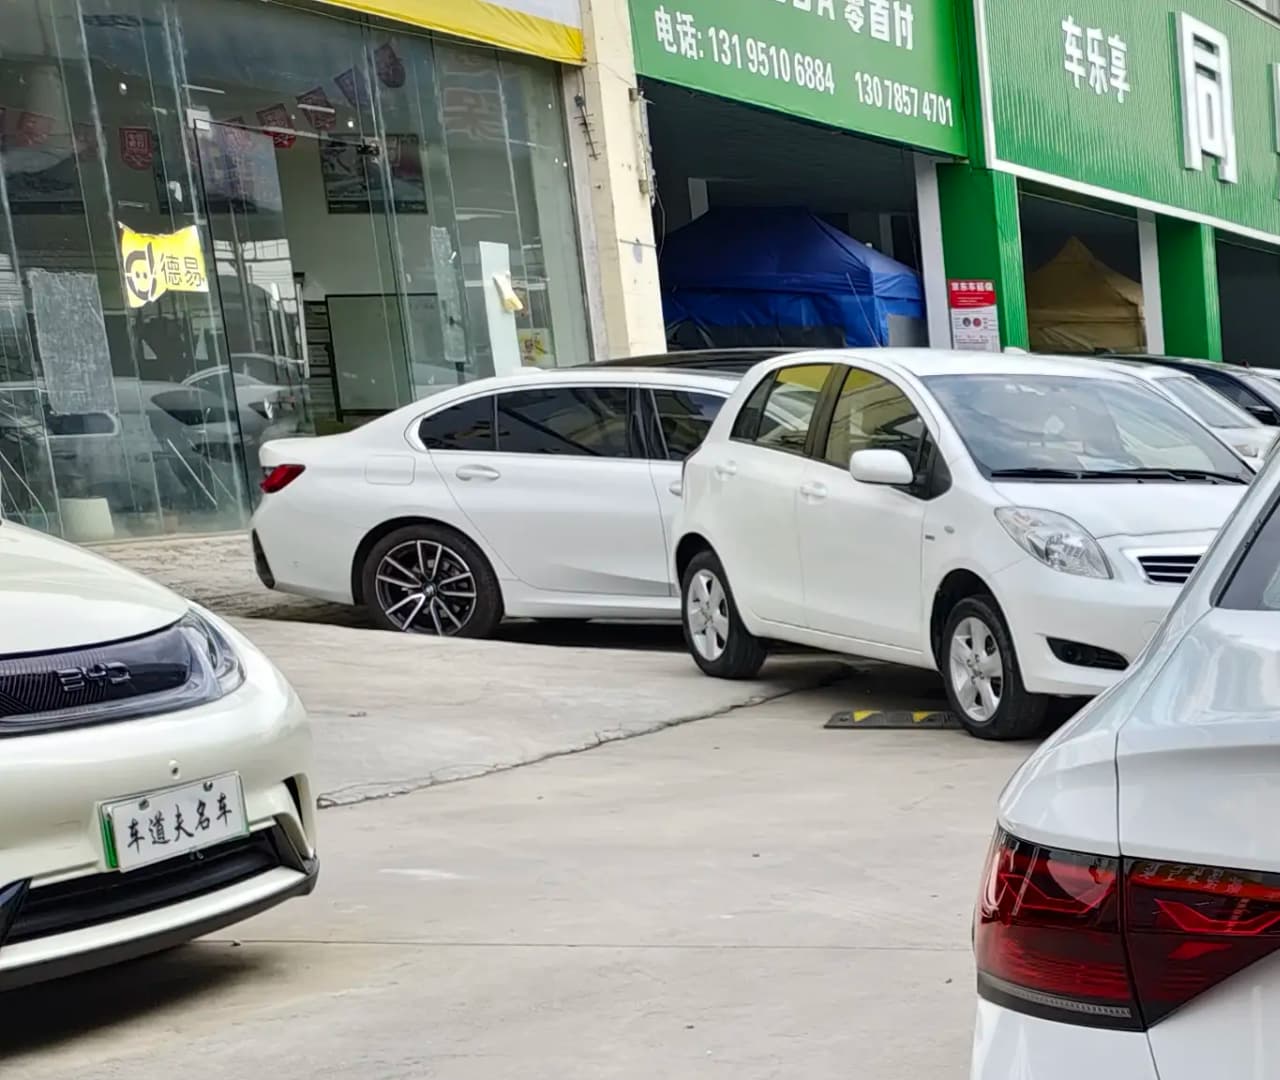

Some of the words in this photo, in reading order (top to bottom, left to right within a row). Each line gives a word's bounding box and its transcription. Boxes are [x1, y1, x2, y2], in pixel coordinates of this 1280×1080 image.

[708, 26, 742, 69] 131
[746, 38, 791, 82] 9510
[794, 52, 835, 95] 6884
[855, 71, 883, 107] 130
[884, 79, 918, 117] 7857
[922, 91, 953, 127] 4701
[1061, 15, 1130, 104] 车乐享
